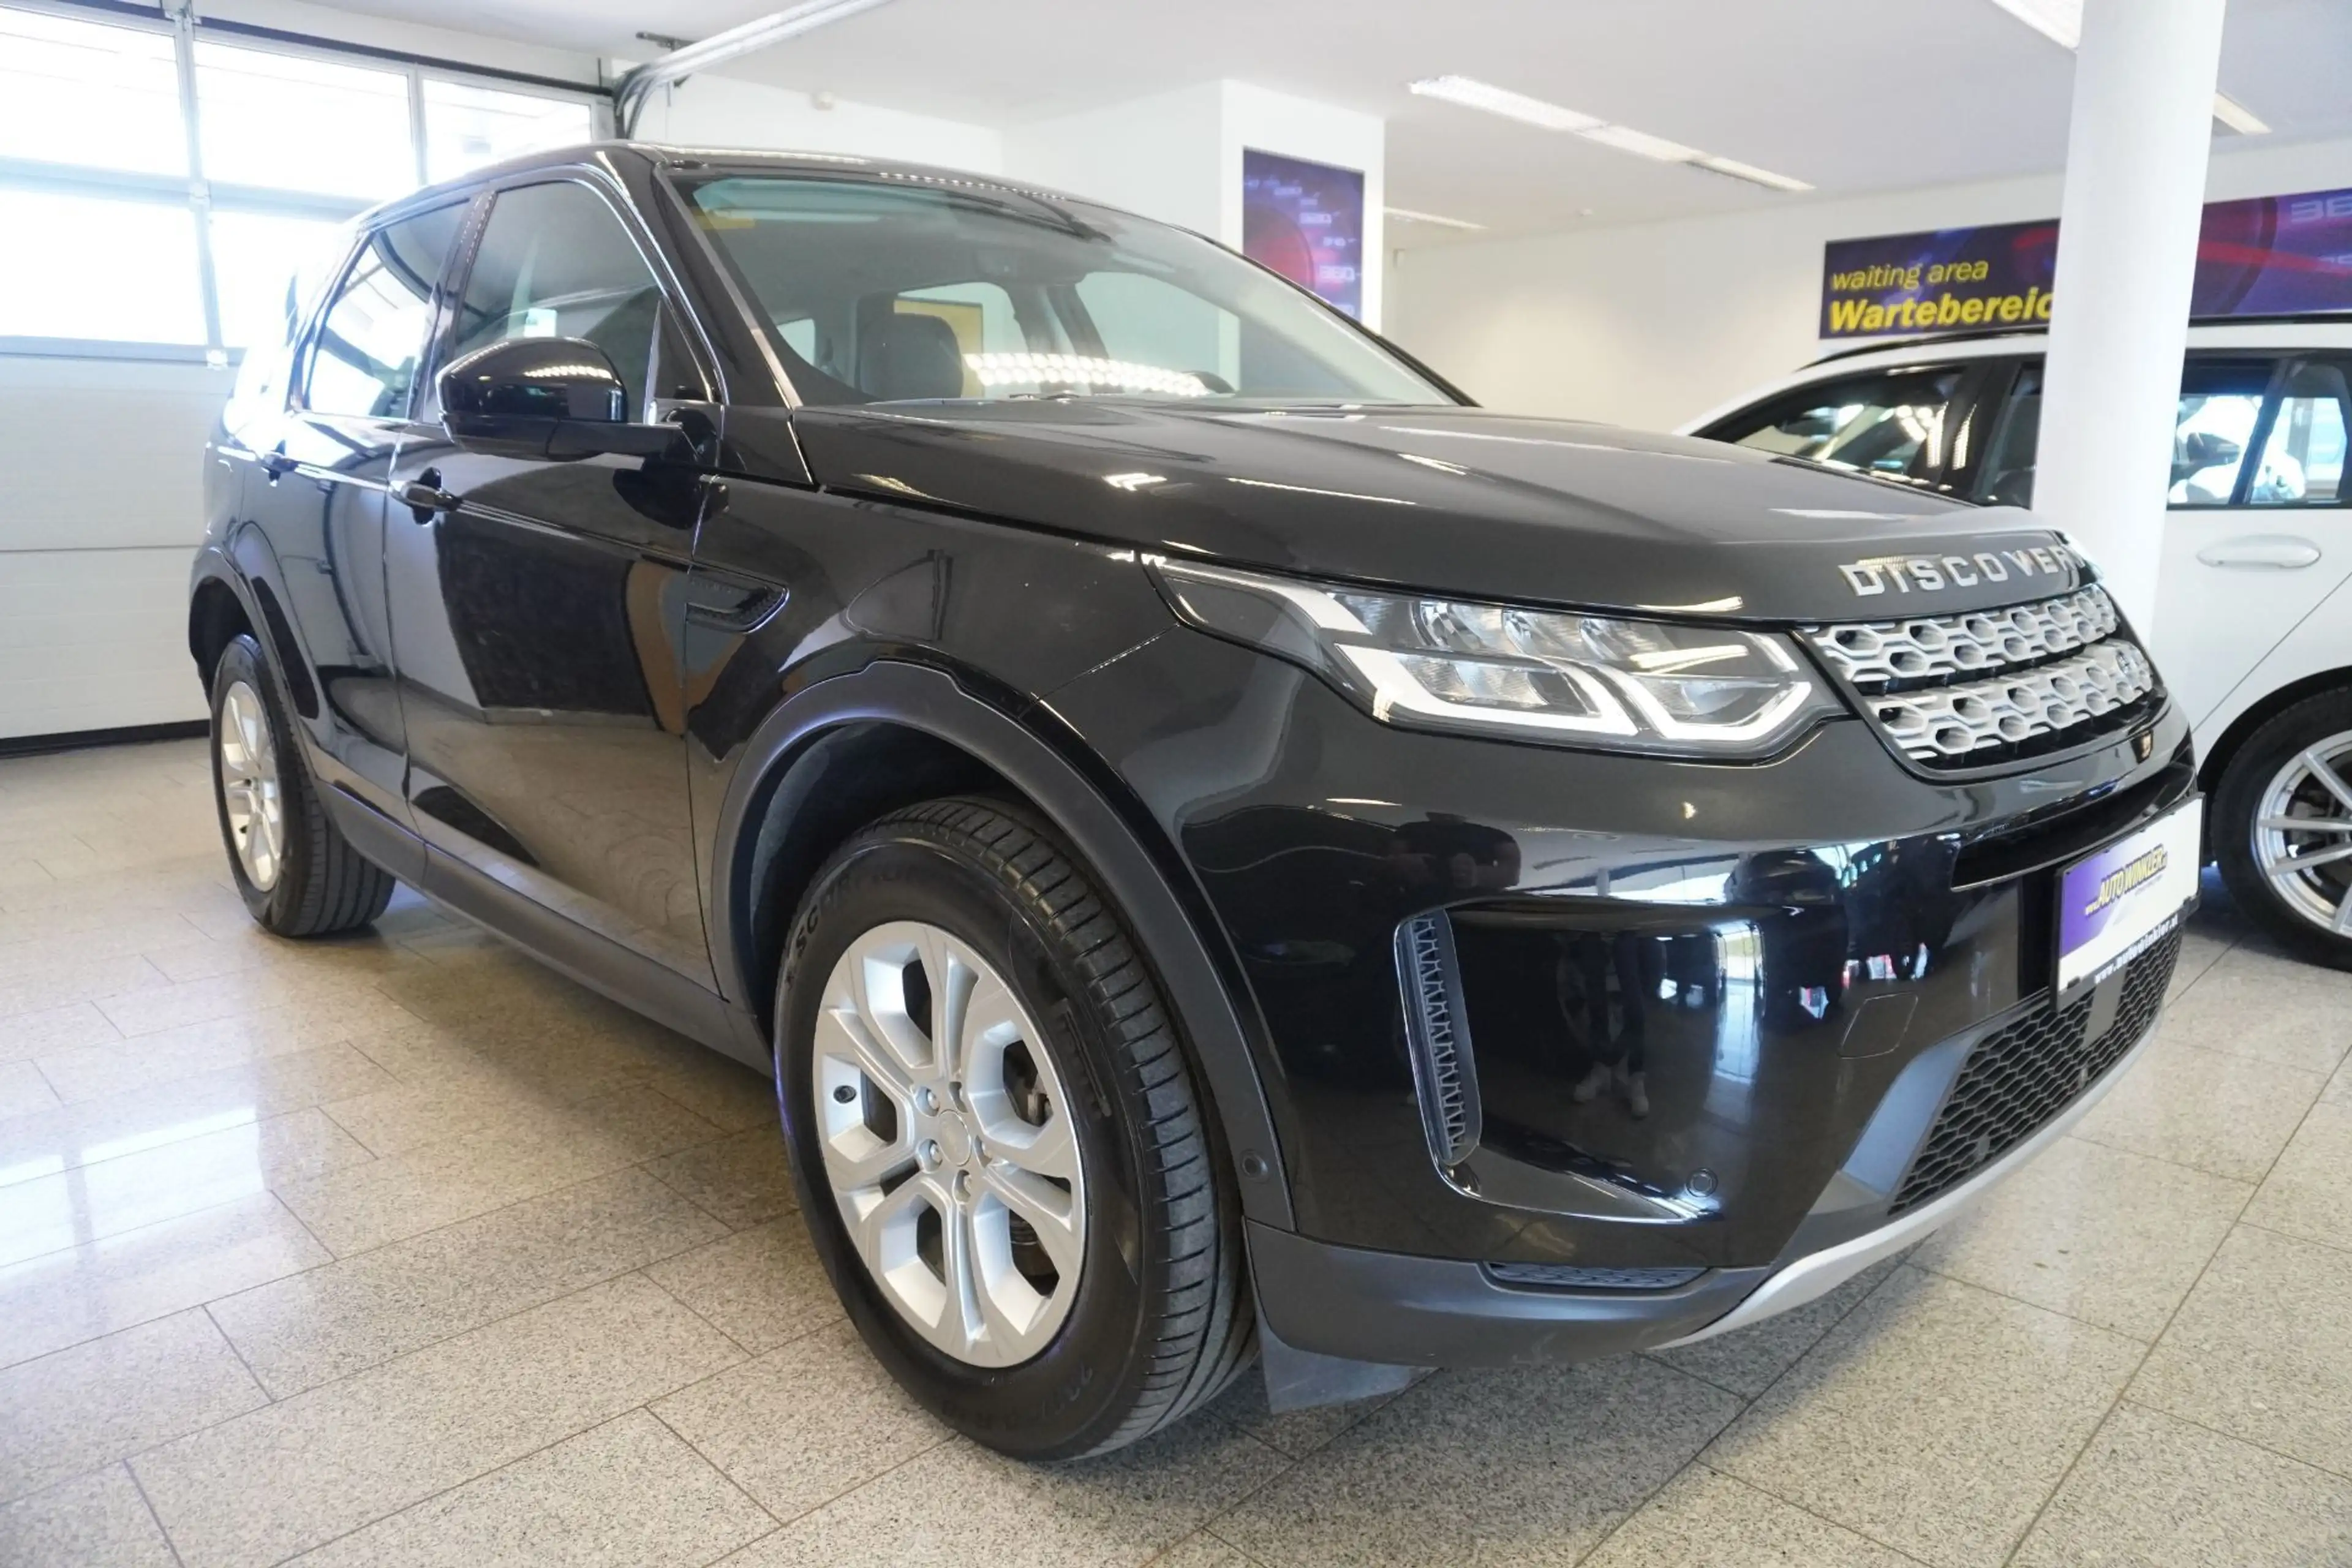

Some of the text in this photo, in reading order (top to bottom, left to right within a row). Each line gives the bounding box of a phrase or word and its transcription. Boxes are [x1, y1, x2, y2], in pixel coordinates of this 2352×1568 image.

[1831, 260, 1989, 290] waiting area
[1830, 285, 2054, 333] Wartebereic
